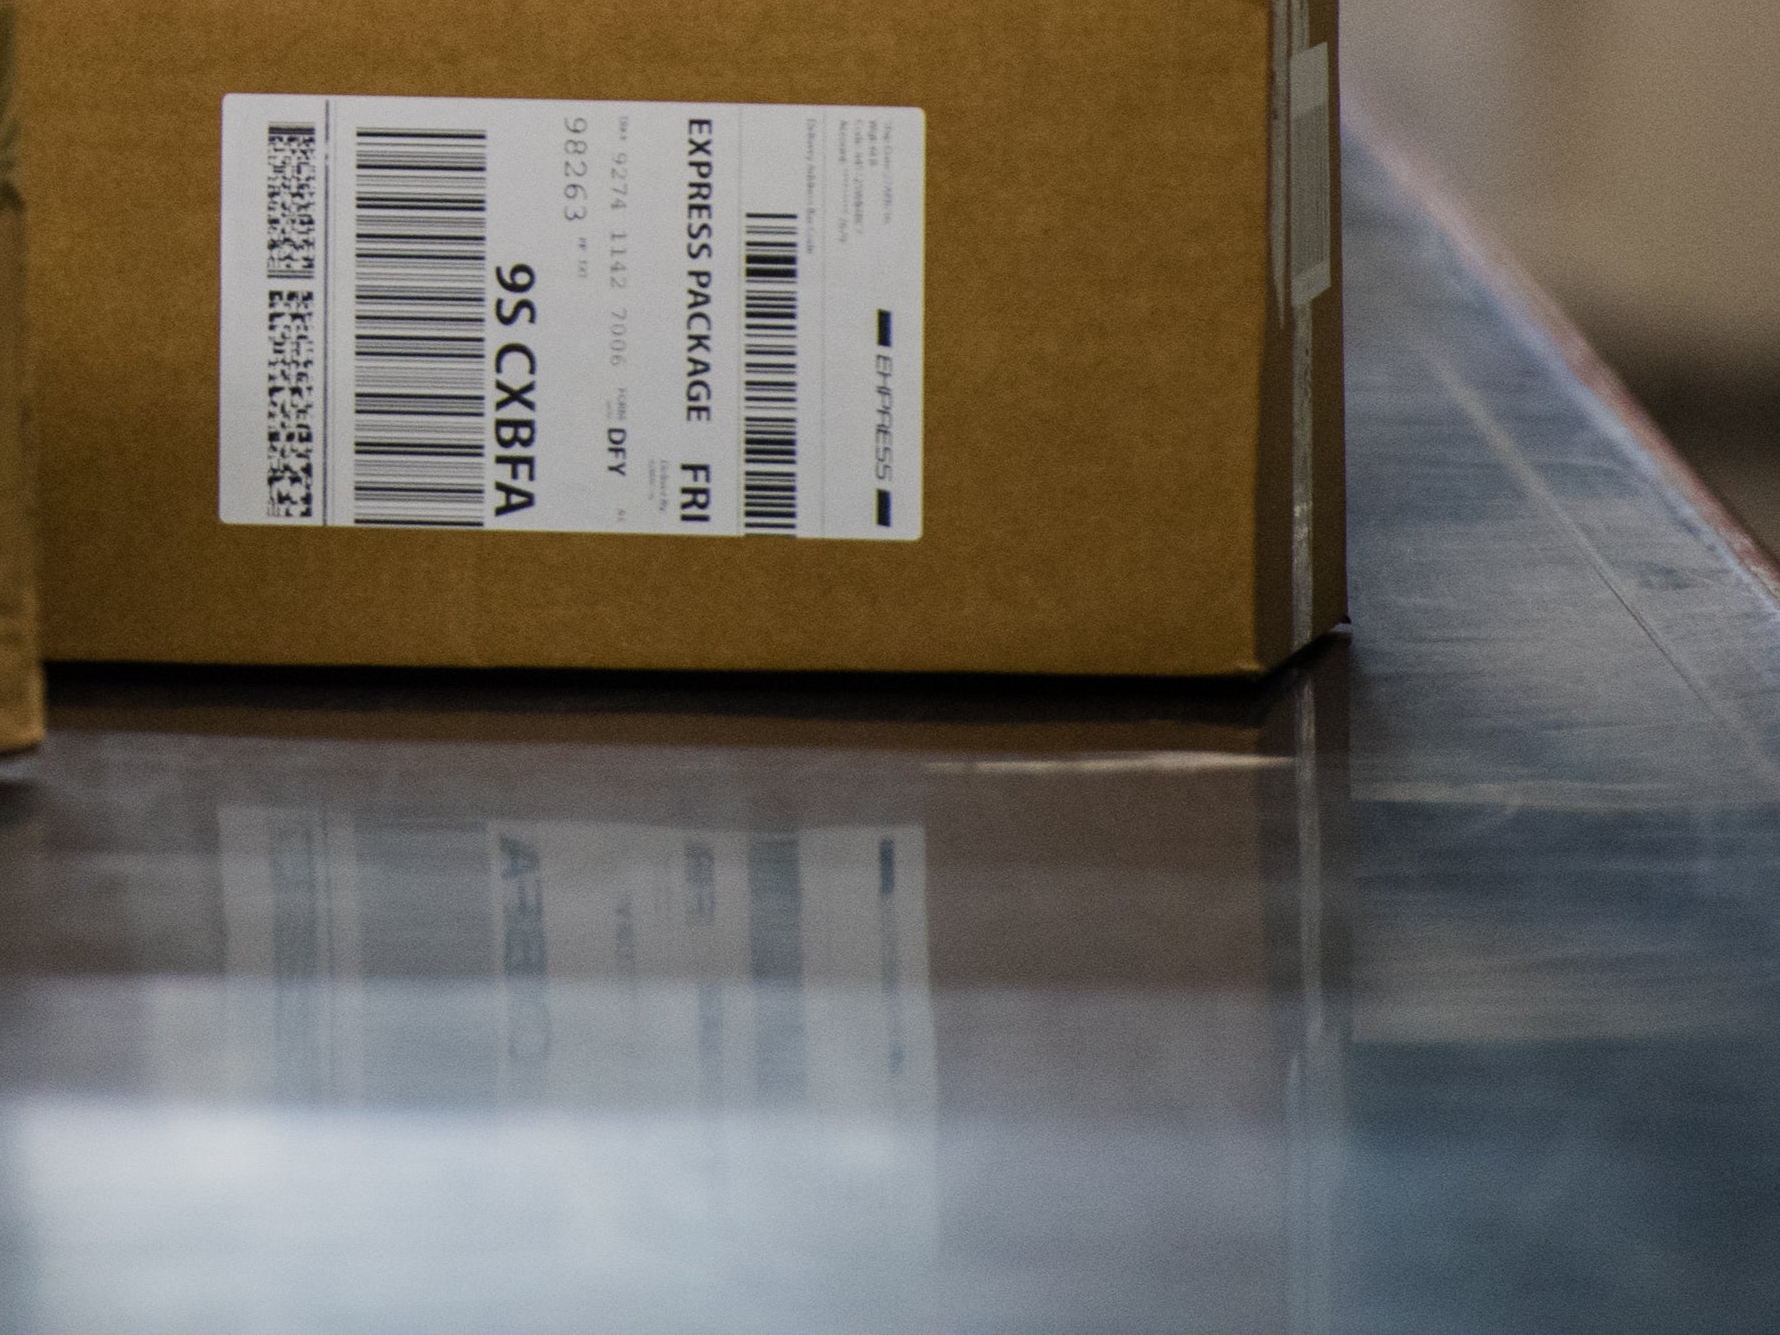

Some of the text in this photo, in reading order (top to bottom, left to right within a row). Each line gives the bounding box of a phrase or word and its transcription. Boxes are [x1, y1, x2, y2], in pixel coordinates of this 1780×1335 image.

[563, 117, 588, 222] 98263
[610, 152, 628, 210] 9274
[610, 231, 628, 289] 1142
[610, 308, 628, 366] 7006
[680, 118, 713, 523] EXPRESS PACKAGE FRI
[494, 264, 537, 518] 9S CXBFA
[608, 428, 627, 476] DFY
